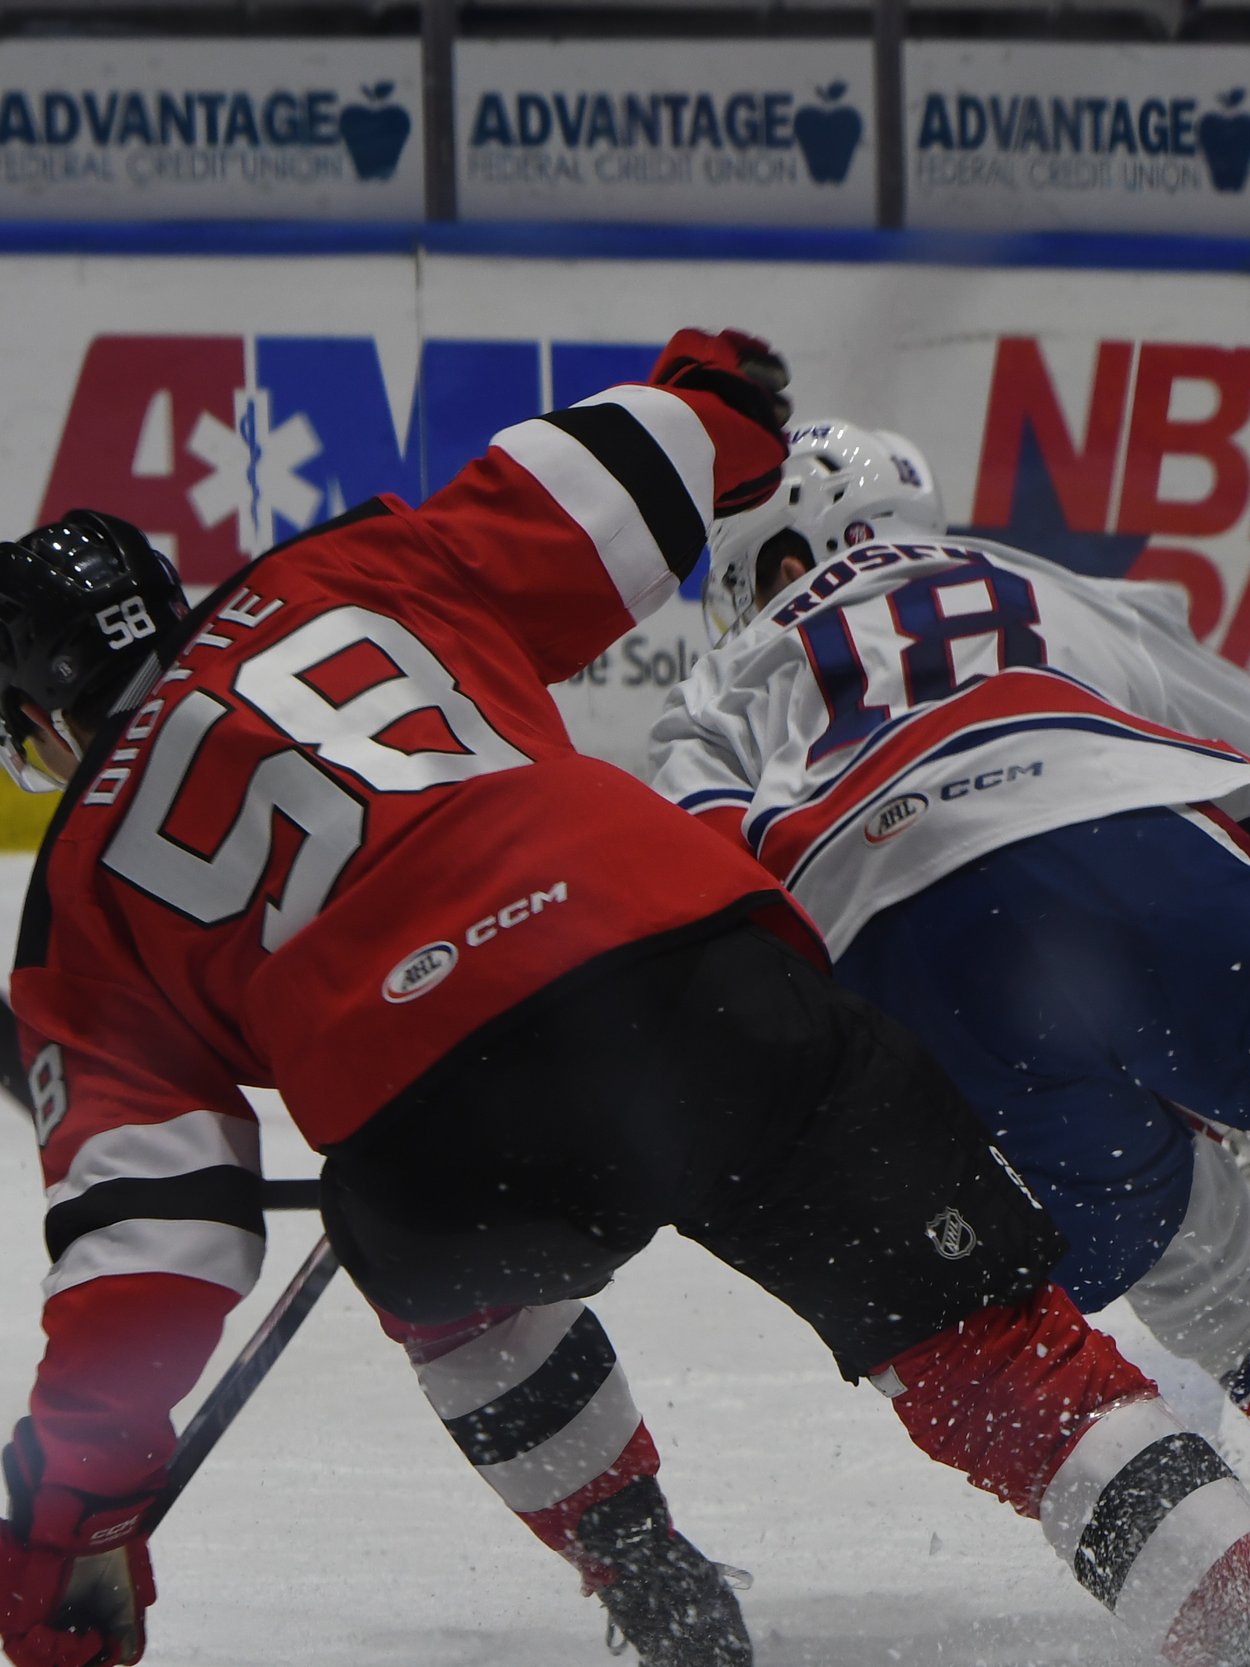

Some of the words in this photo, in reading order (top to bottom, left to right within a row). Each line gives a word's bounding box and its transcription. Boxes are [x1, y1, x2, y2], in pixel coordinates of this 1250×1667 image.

[0, 91, 342, 147] ADVANTAGE
[471, 92, 795, 149] ADVANTAGE
[918, 92, 1197, 156] ADVANTAGE
[125, 150, 230, 183] CREDIT
[242, 150, 343, 182] UNION
[468, 150, 584, 183] FEDERAL
[594, 151, 692, 184] CREDIT
[704, 153, 797, 185] UNION
[917, 154, 1013, 187] FEDERAL
[1029, 157, 1110, 190] CREDIT
[1121, 160, 1199, 193] UNION
[96, 595, 156, 650] 58
[622, 634, 700, 688] Sol
[796, 558, 1048, 771] 18
[82, 586, 285, 806] DIOTTE
[100, 603, 537, 955] 58
[940, 761, 1044, 802] CCM
[464, 880, 569, 947] CCM
